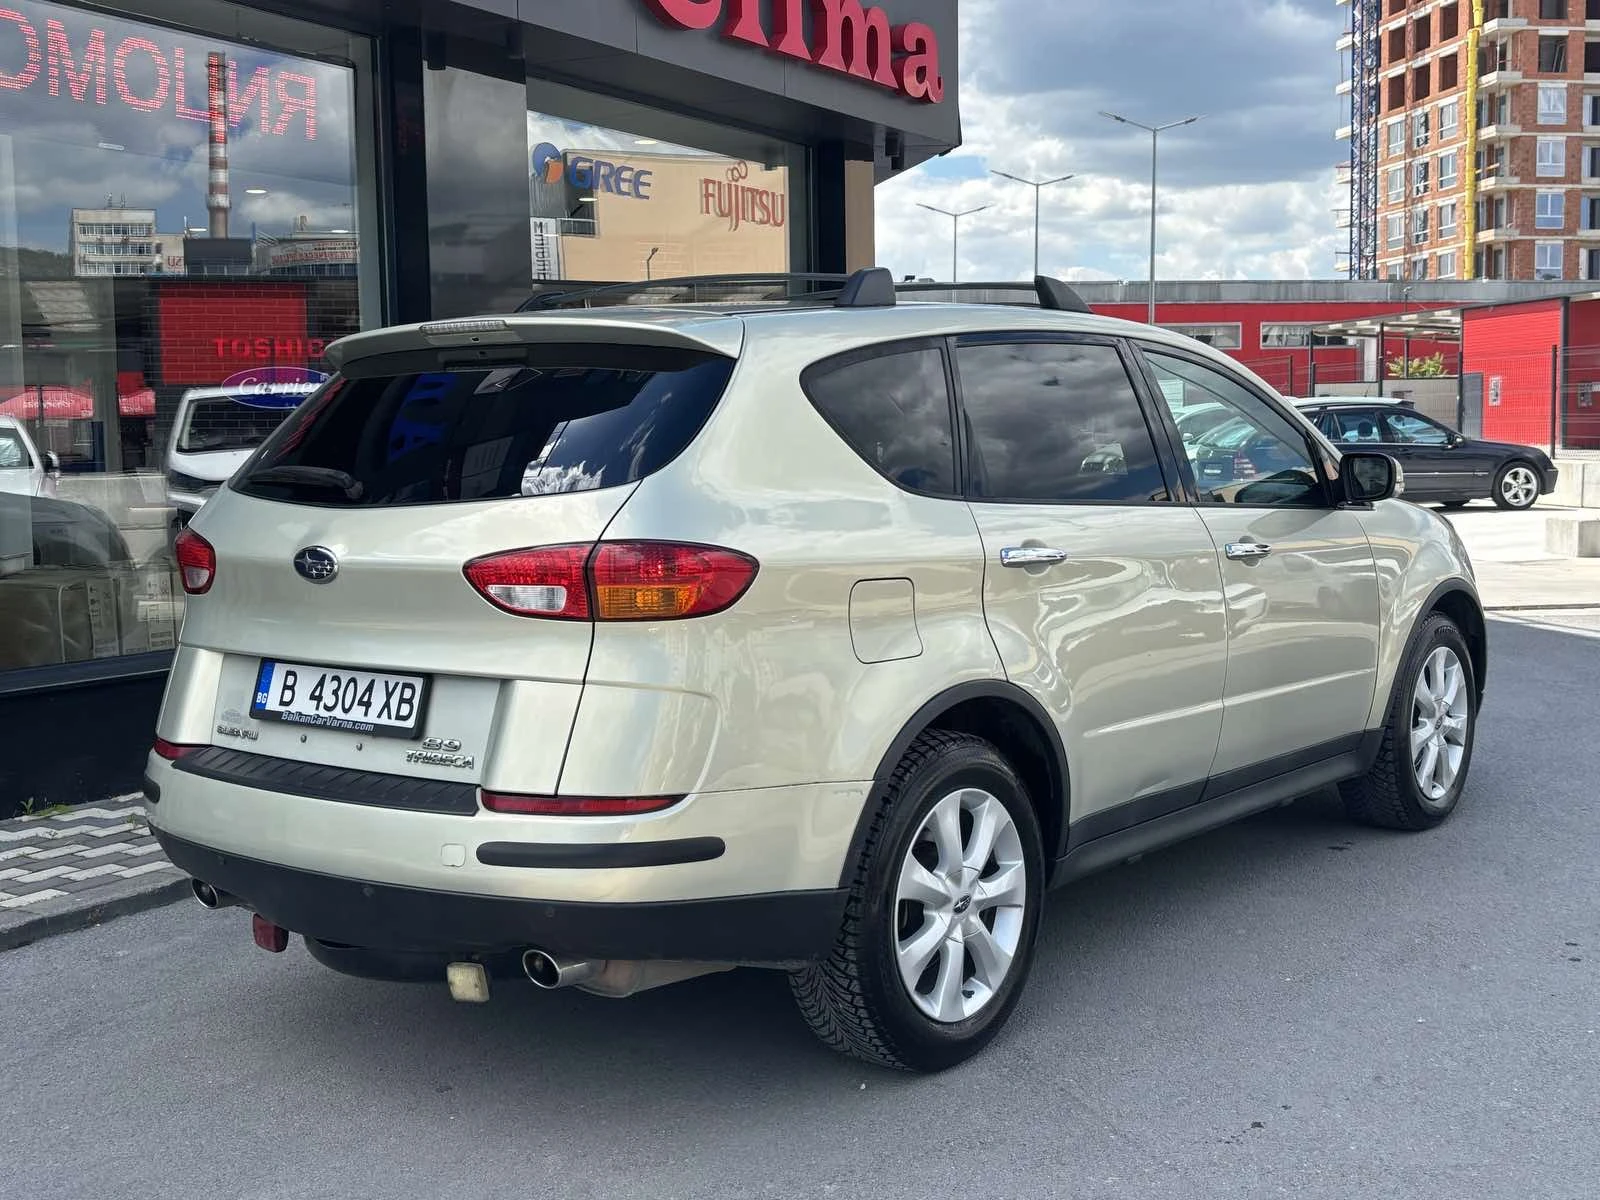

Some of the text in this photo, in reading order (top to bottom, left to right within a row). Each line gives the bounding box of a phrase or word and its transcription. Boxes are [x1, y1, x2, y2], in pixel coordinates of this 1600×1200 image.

[568, 155, 653, 201] GREE
[702, 177, 785, 232] FUJITSU
[213, 337, 326, 359] TOSHIB
[256, 692, 268, 704] BG
[279, 670, 416, 722] B 4304 XB
[281, 711, 375, 732] BalkanCarVarna.com
[422, 736, 462, 752] B9
[405, 750, 475, 770] TRIBECA
